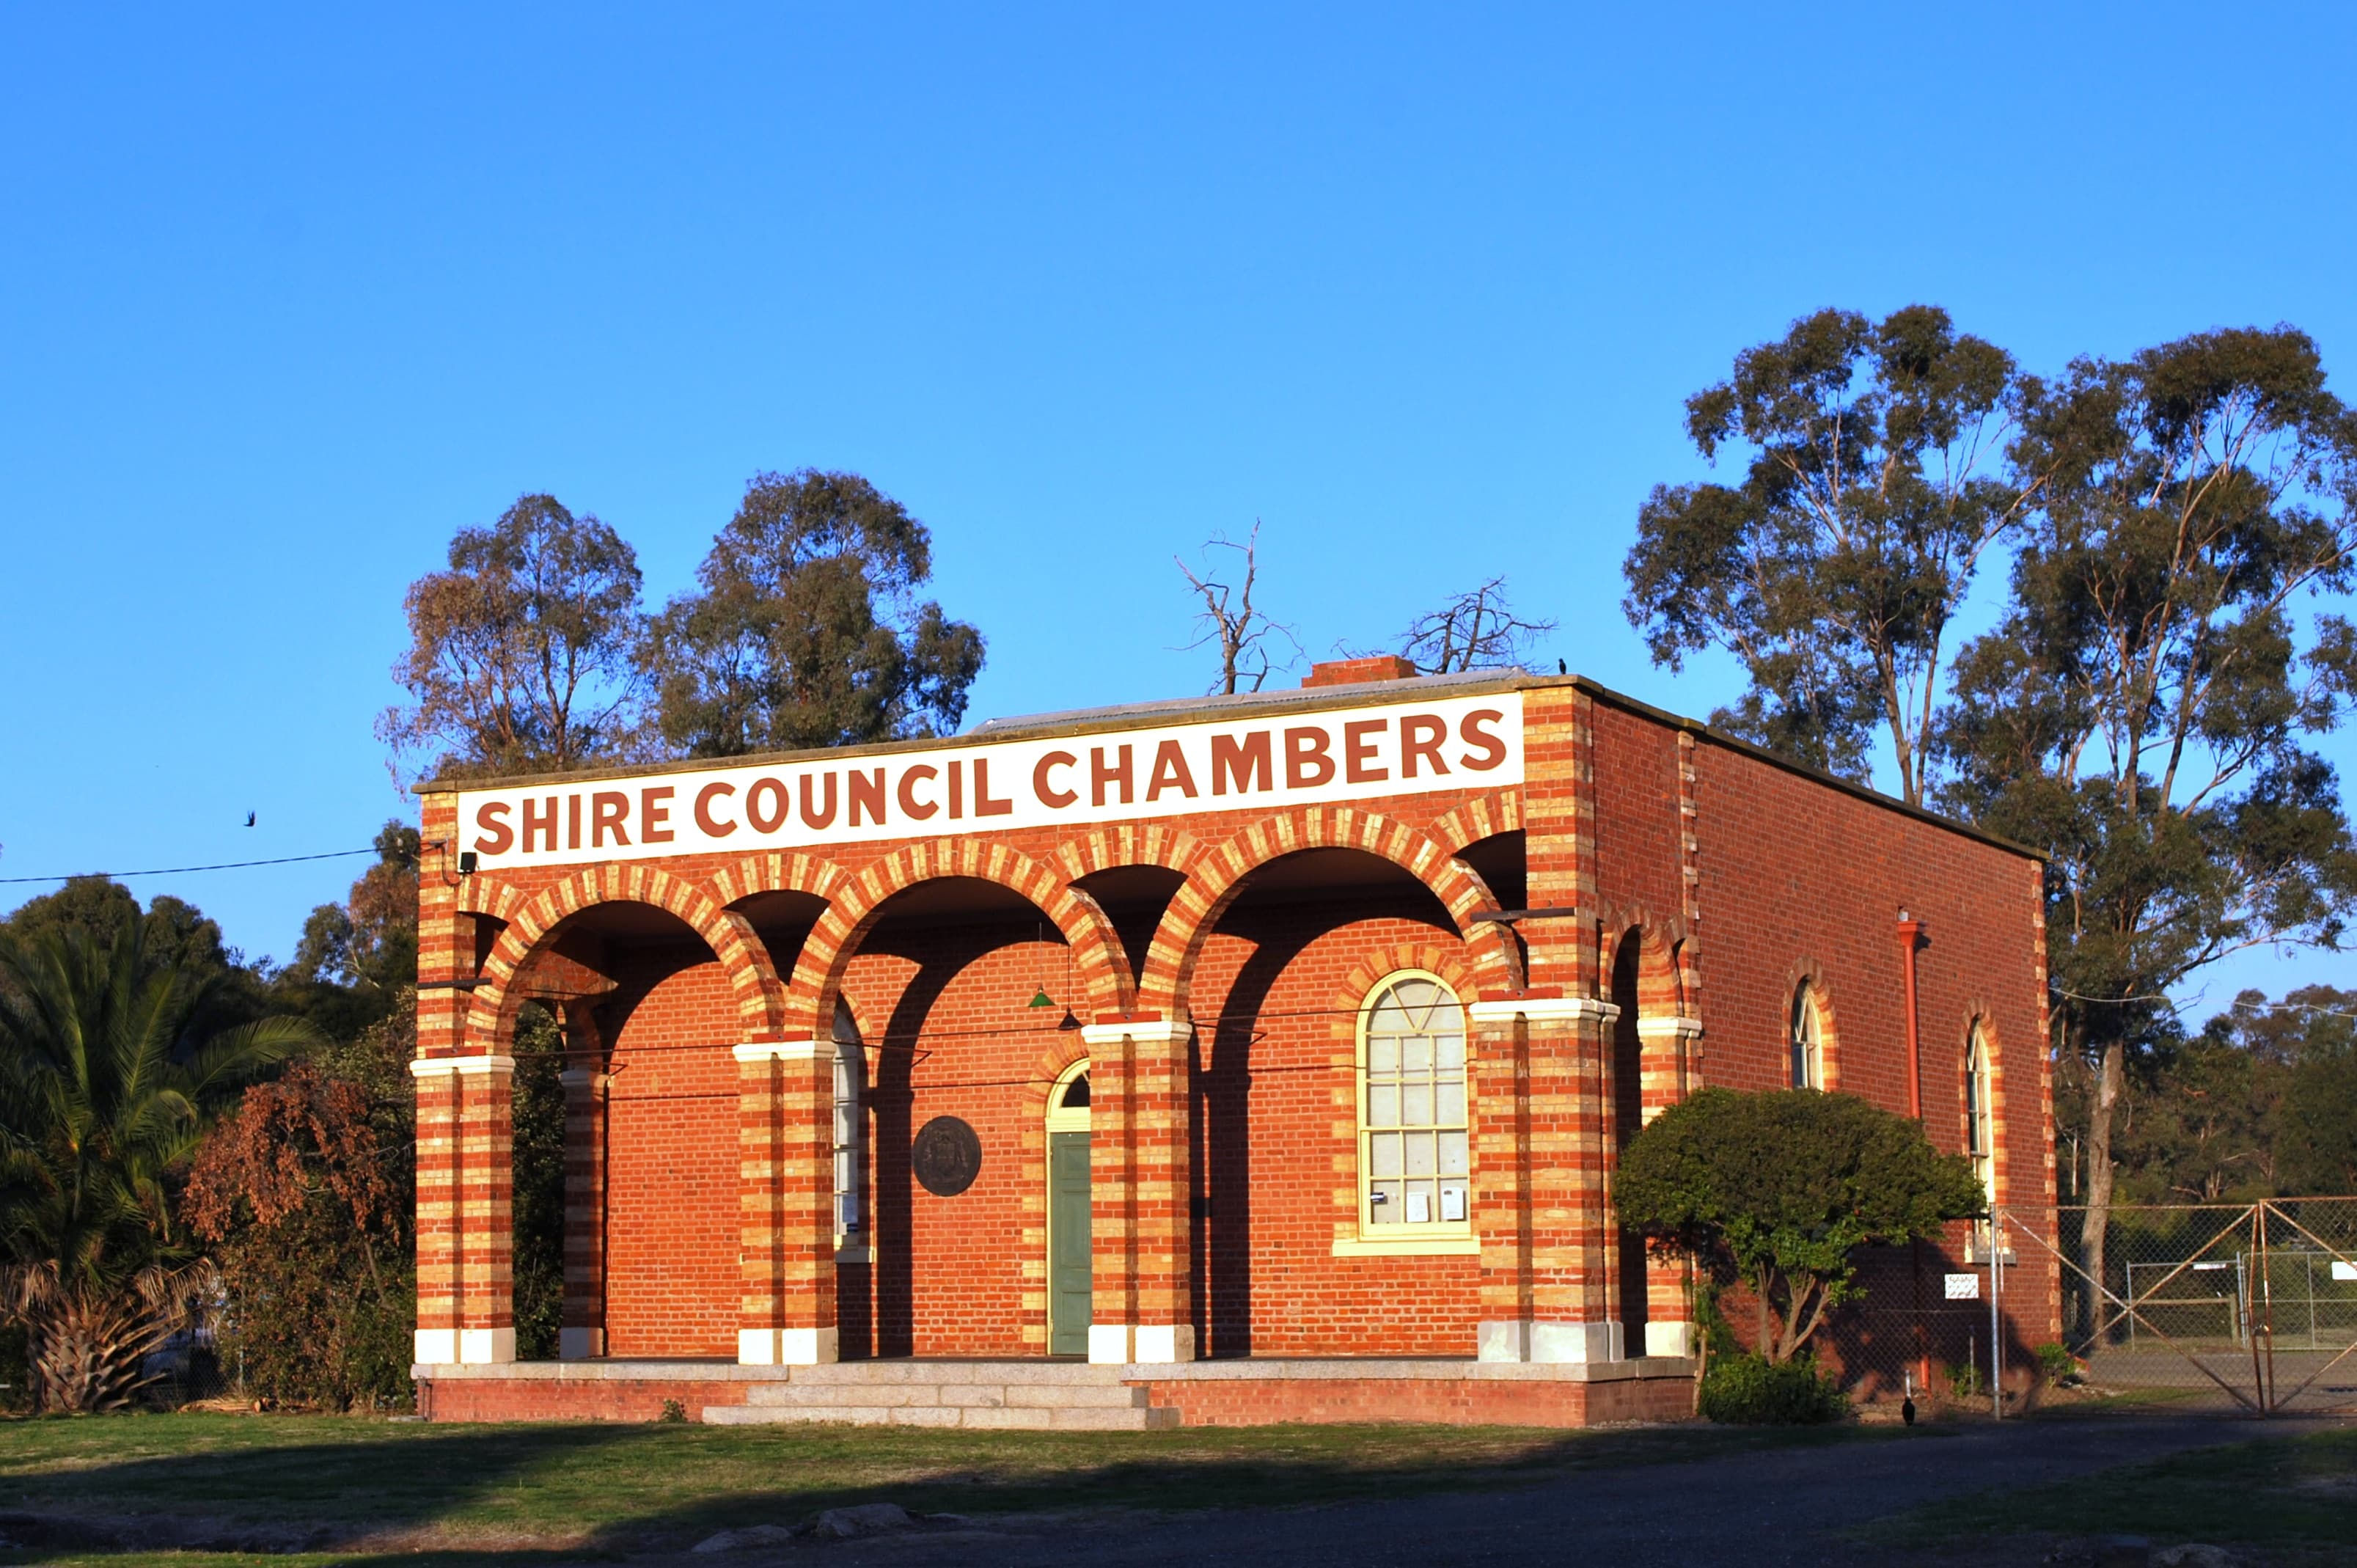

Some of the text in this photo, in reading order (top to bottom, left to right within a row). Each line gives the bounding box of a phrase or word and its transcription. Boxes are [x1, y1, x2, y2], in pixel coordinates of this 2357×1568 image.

[473, 709, 1507, 855] SHIRE COUNCIL CHAMBERS
